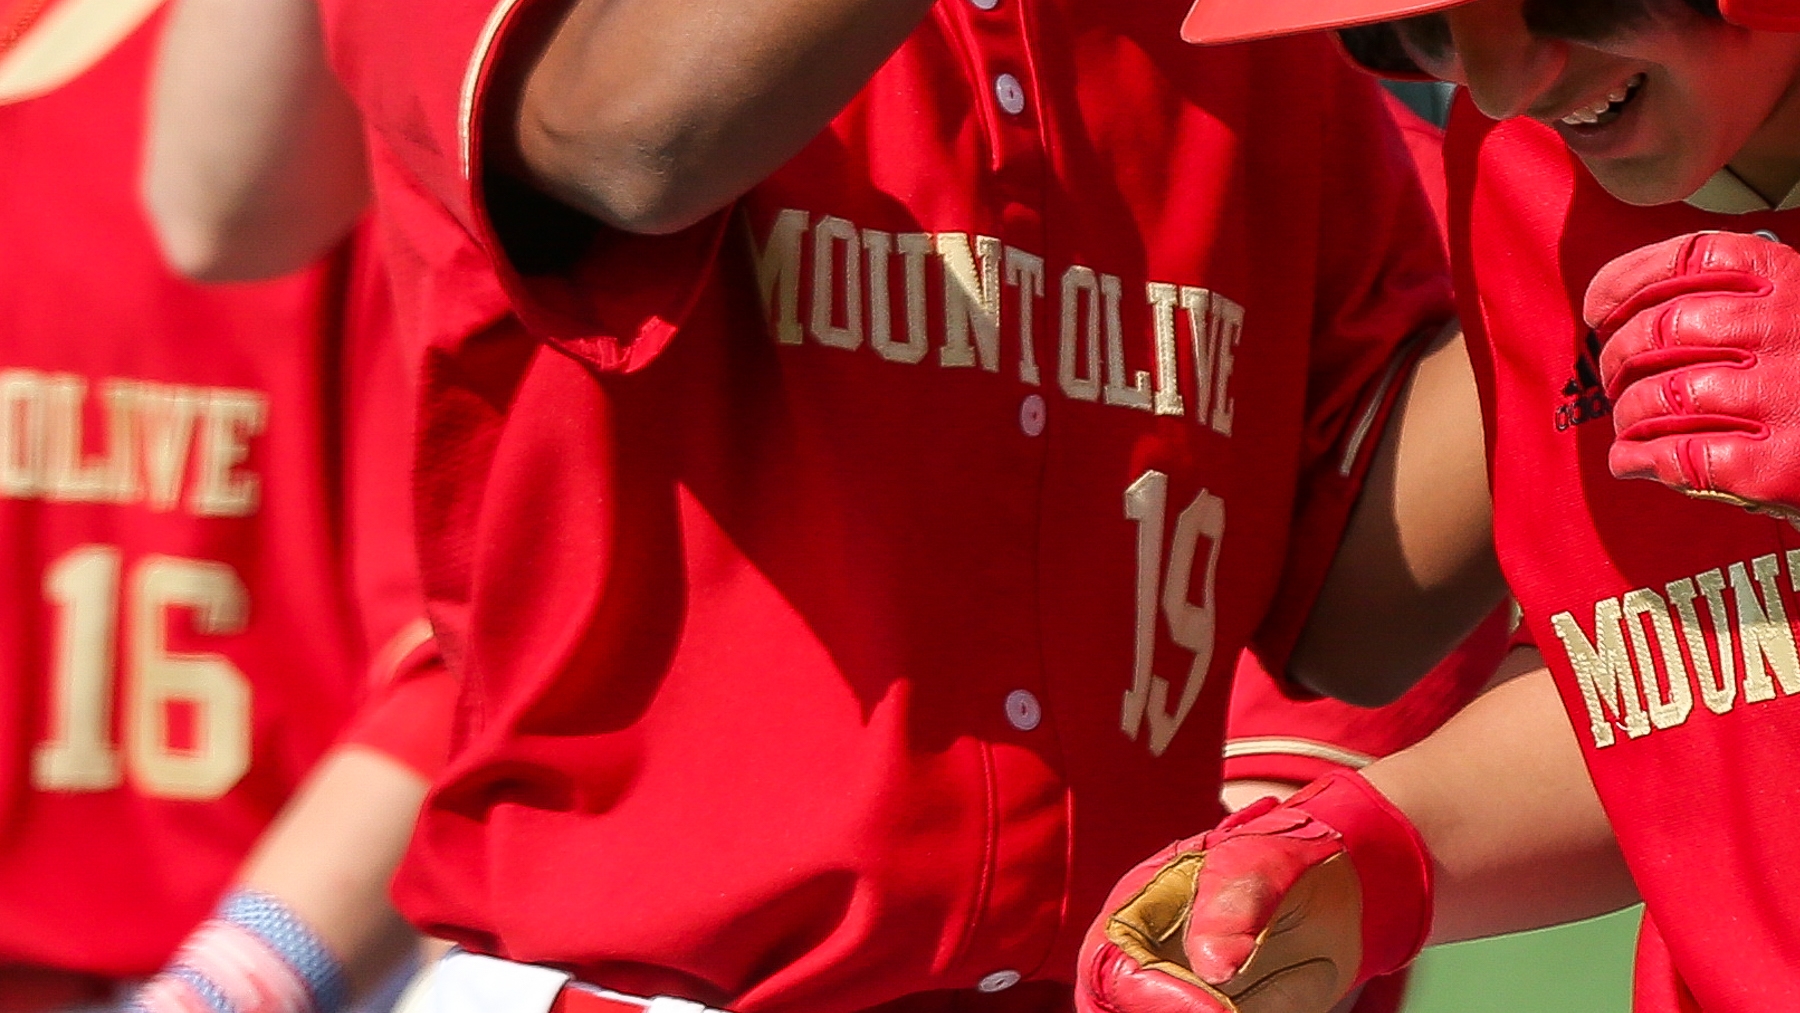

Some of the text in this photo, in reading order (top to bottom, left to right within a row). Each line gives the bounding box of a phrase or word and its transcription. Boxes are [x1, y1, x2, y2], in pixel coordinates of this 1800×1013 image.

[0, 368, 270, 518] OLIVE
[743, 204, 1246, 438] MOUNT OLIVE
[32, 543, 254, 802] 16
[1120, 469, 1227, 758] 19
